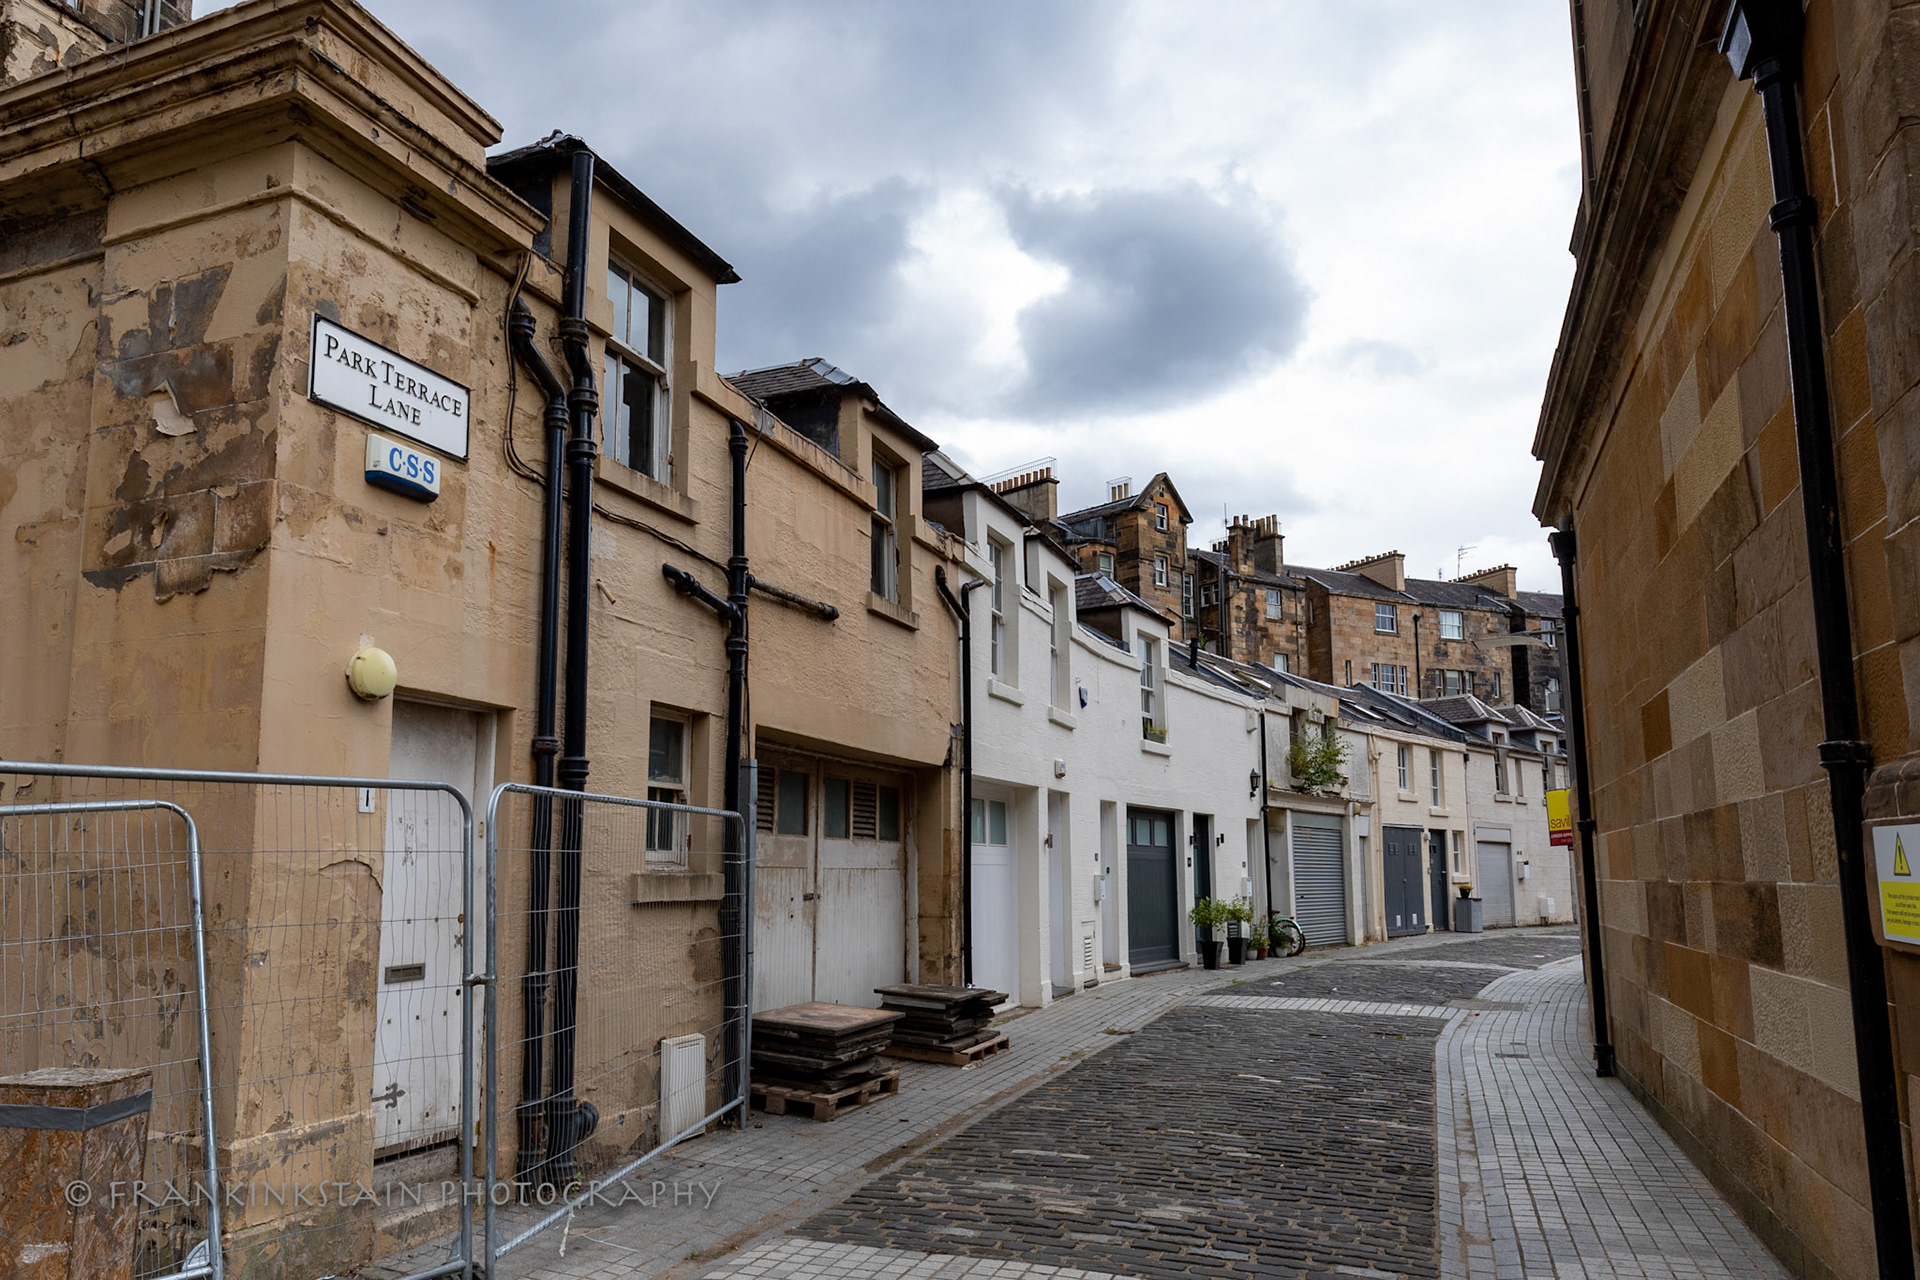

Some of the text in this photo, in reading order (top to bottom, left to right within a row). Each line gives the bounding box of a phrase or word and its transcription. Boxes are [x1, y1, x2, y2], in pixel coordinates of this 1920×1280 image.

[324, 333, 462, 417] PARK TERRACE
[368, 384, 422, 426] LANE
